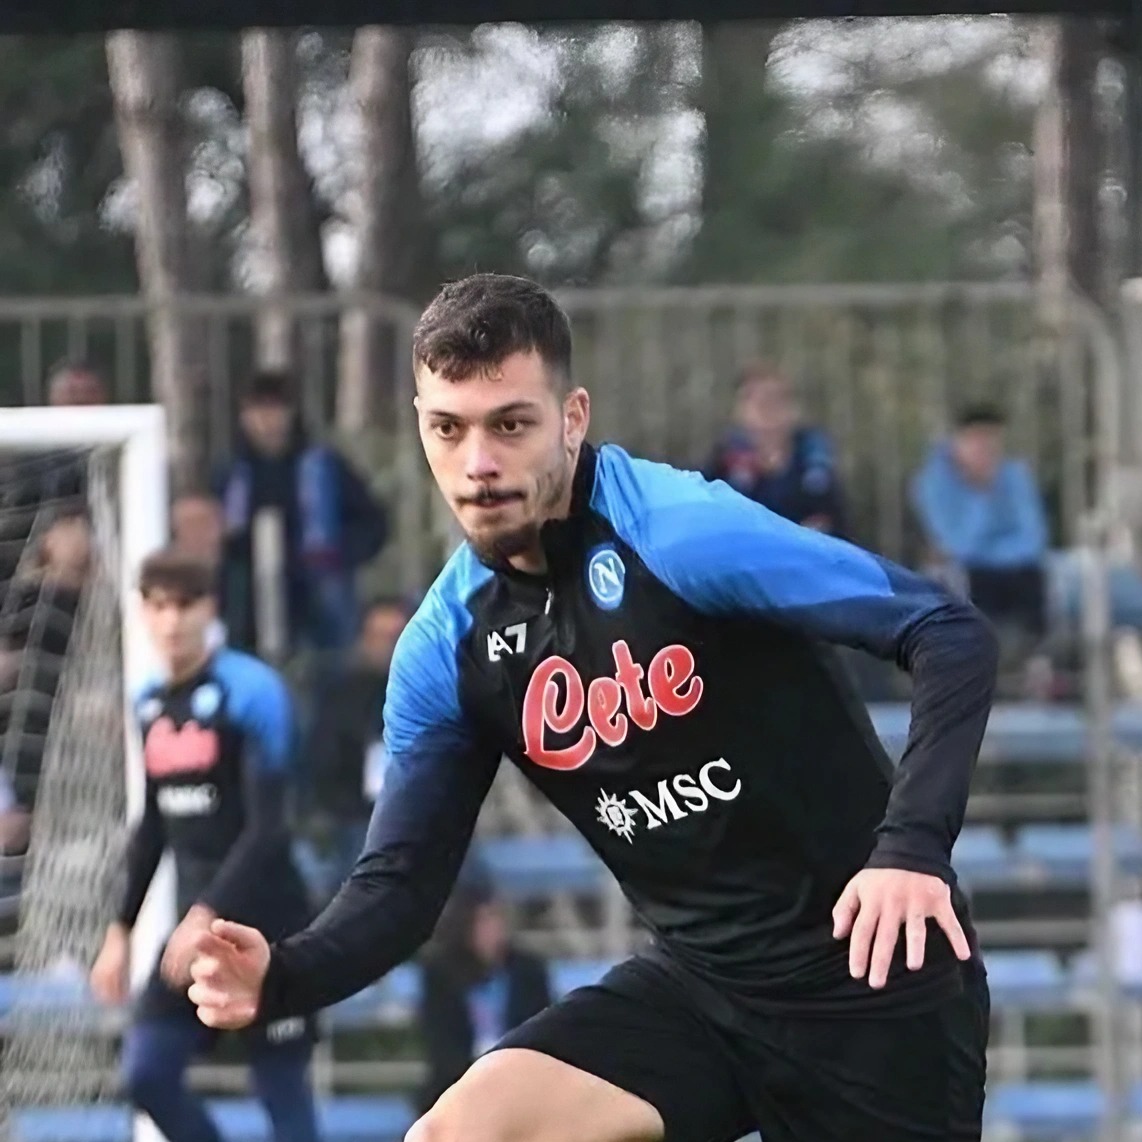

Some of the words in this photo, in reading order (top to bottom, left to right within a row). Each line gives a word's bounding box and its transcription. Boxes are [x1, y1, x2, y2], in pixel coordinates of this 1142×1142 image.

[594, 557, 620, 594] N
[522, 639, 704, 770] Lete
[628, 757, 742, 830] MSC
